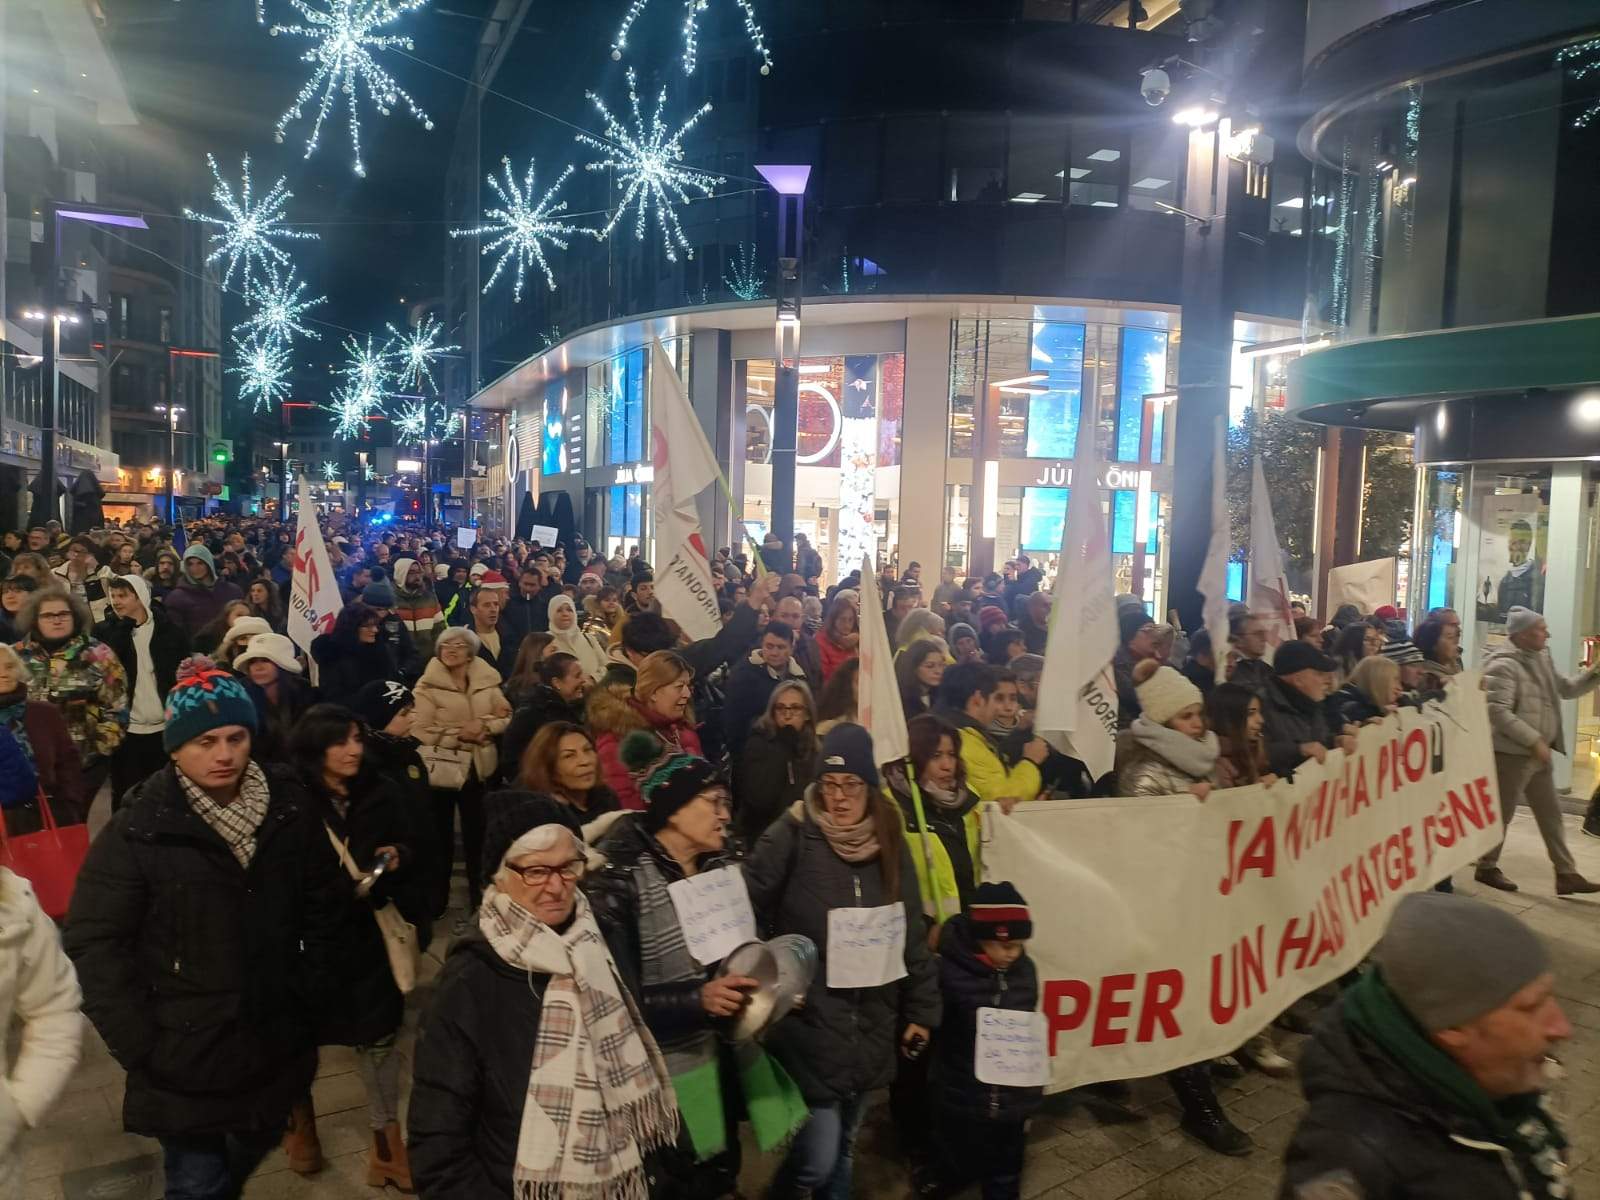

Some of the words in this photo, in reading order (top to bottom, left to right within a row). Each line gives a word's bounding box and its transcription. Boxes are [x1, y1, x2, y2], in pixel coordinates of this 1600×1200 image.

[1219, 816, 1276, 896] JA
[1043, 968, 1184, 1057] PER
[1210, 925, 1268, 1025] UN
